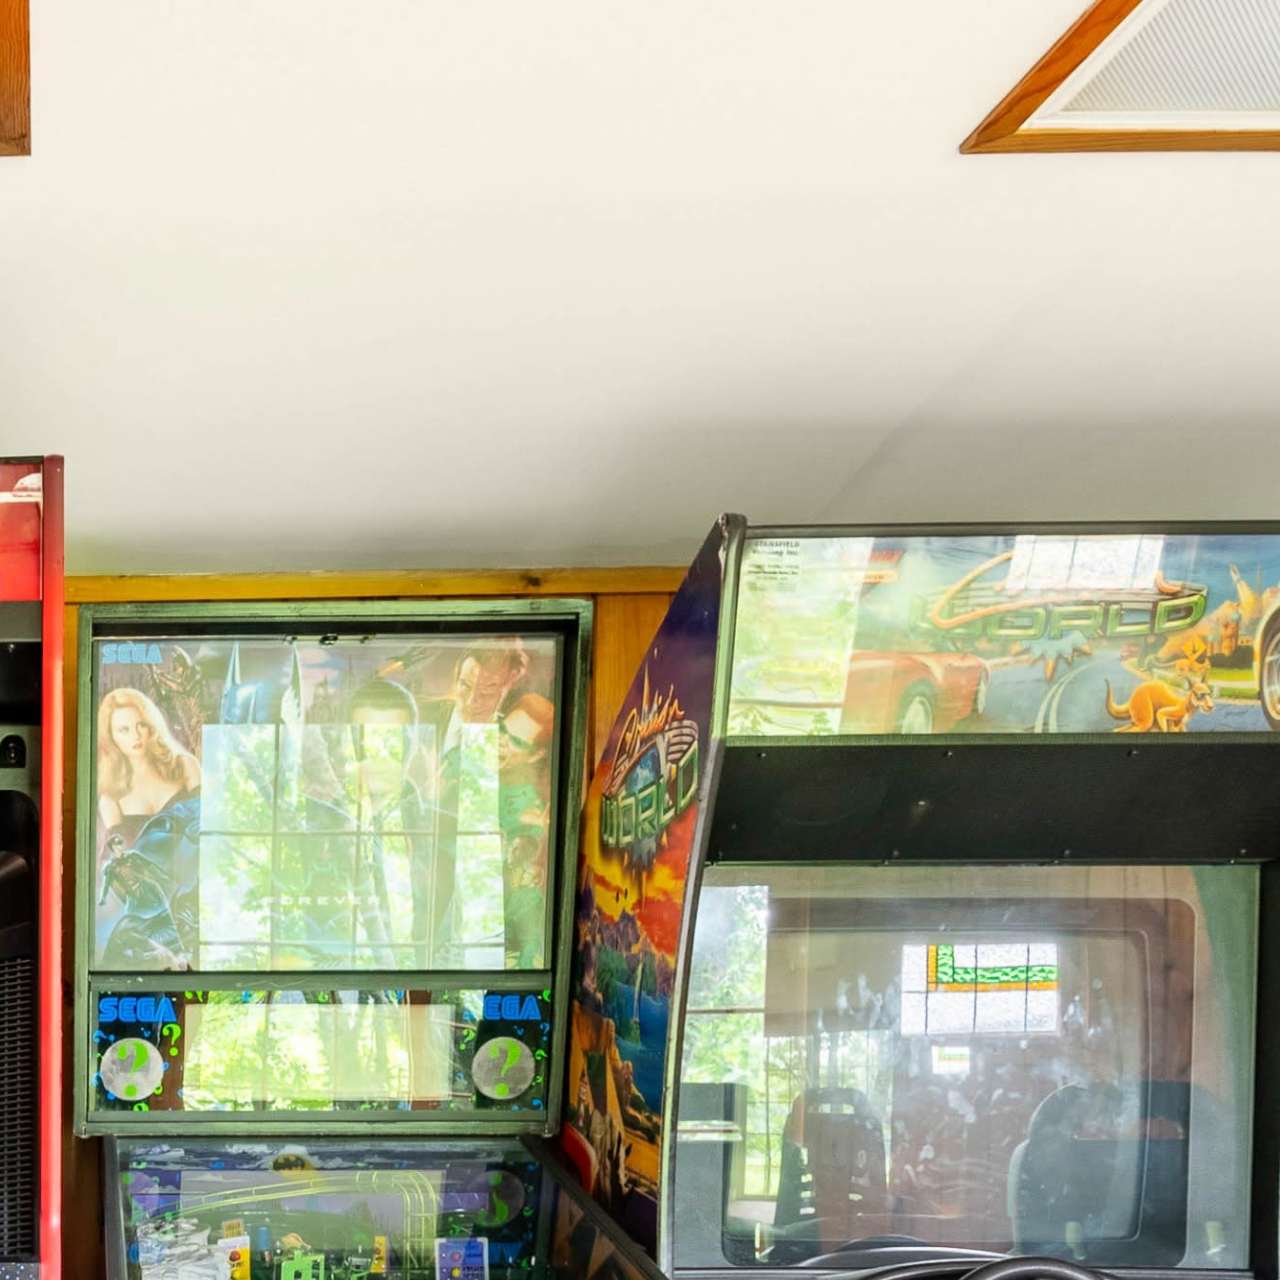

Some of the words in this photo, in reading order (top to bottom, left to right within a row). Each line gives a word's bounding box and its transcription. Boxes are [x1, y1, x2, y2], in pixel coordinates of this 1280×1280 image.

[102, 642, 163, 664] SEGA
[602, 741, 699, 850] WORLD
[98, 996, 177, 1022] SEGA
